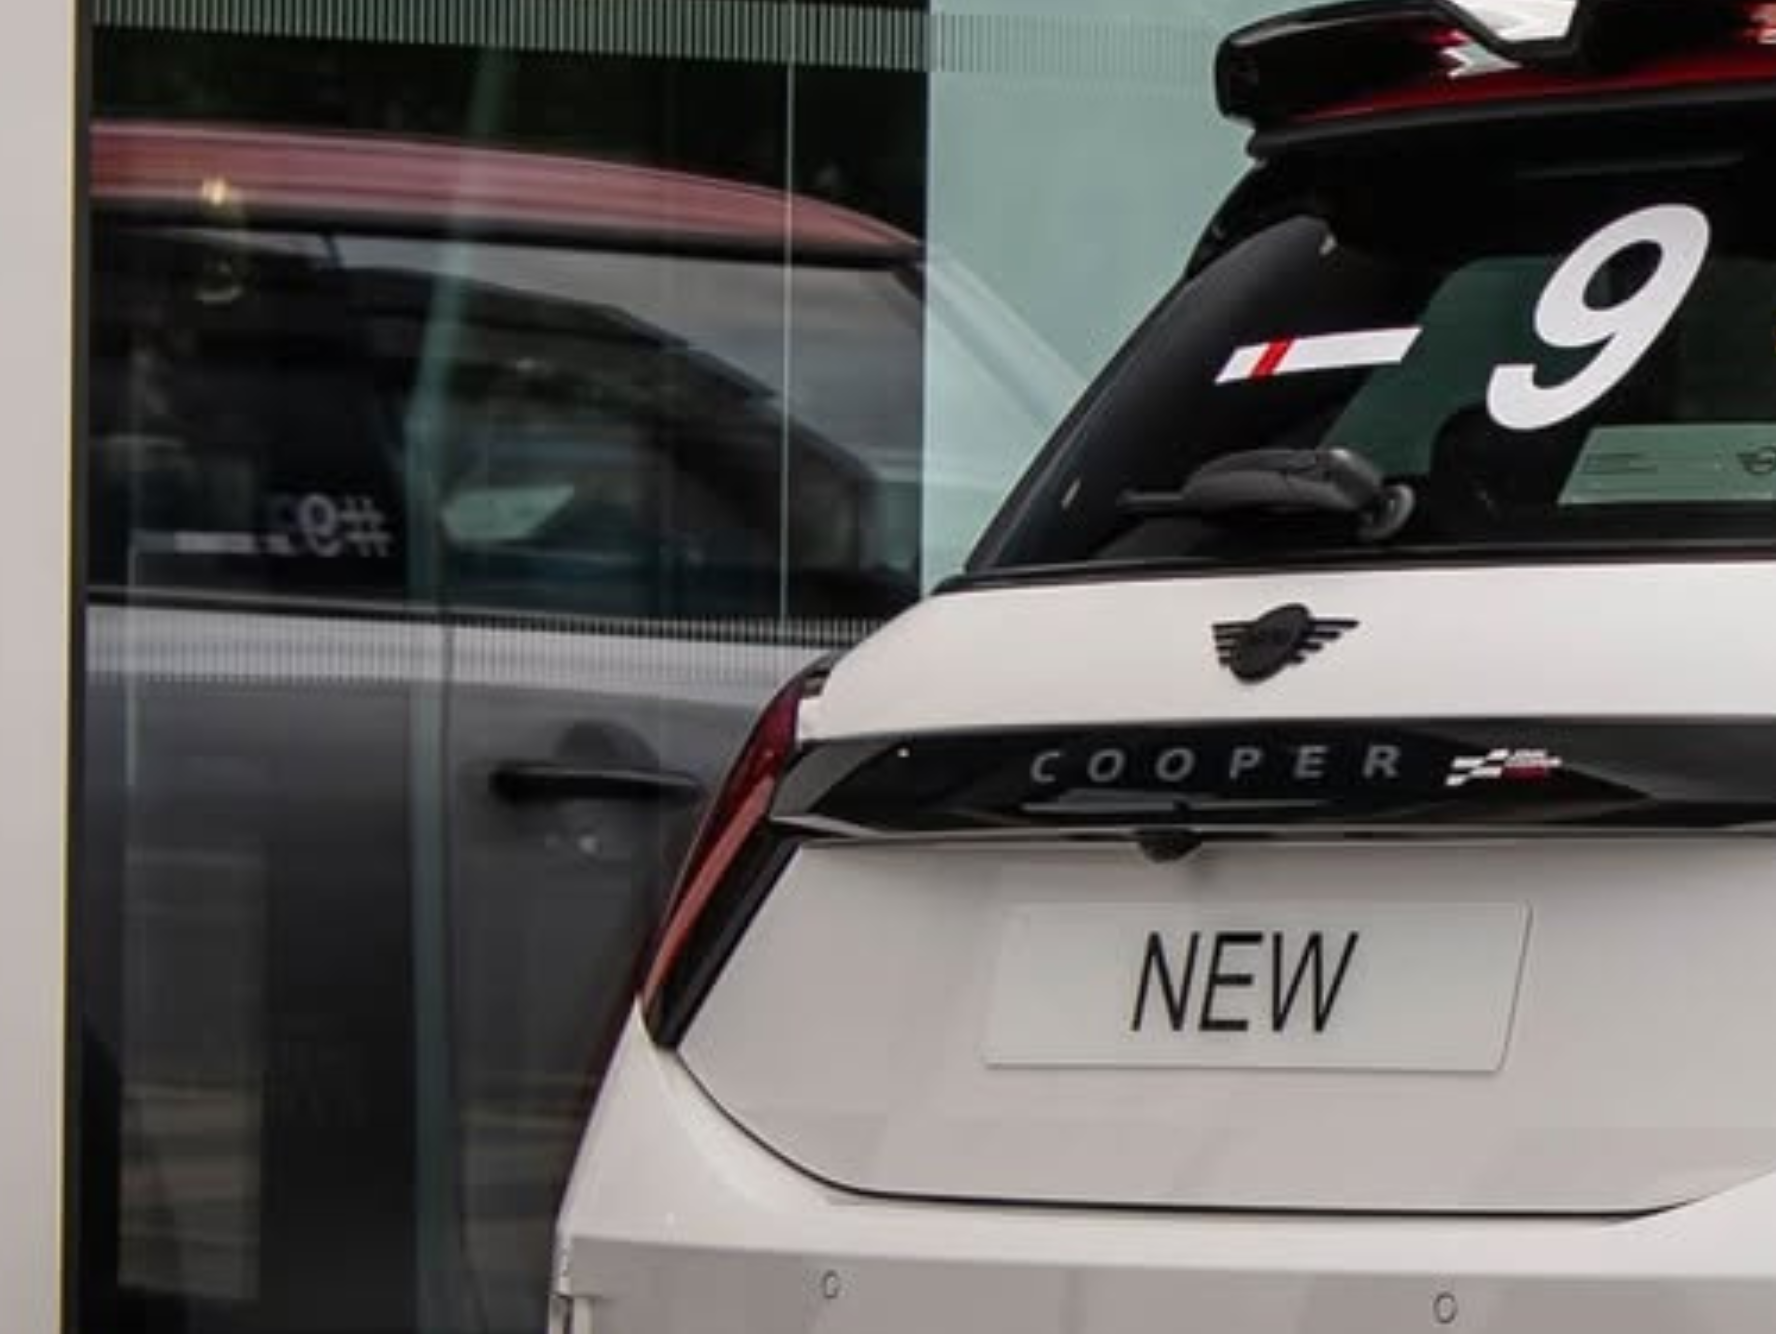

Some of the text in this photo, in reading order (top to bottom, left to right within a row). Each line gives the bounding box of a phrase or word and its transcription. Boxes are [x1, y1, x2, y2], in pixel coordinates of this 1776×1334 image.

[1486, 202, 1711, 430] 9
[1029, 744, 1401, 784] COOPER
[1130, 930, 1360, 1032] NEW
